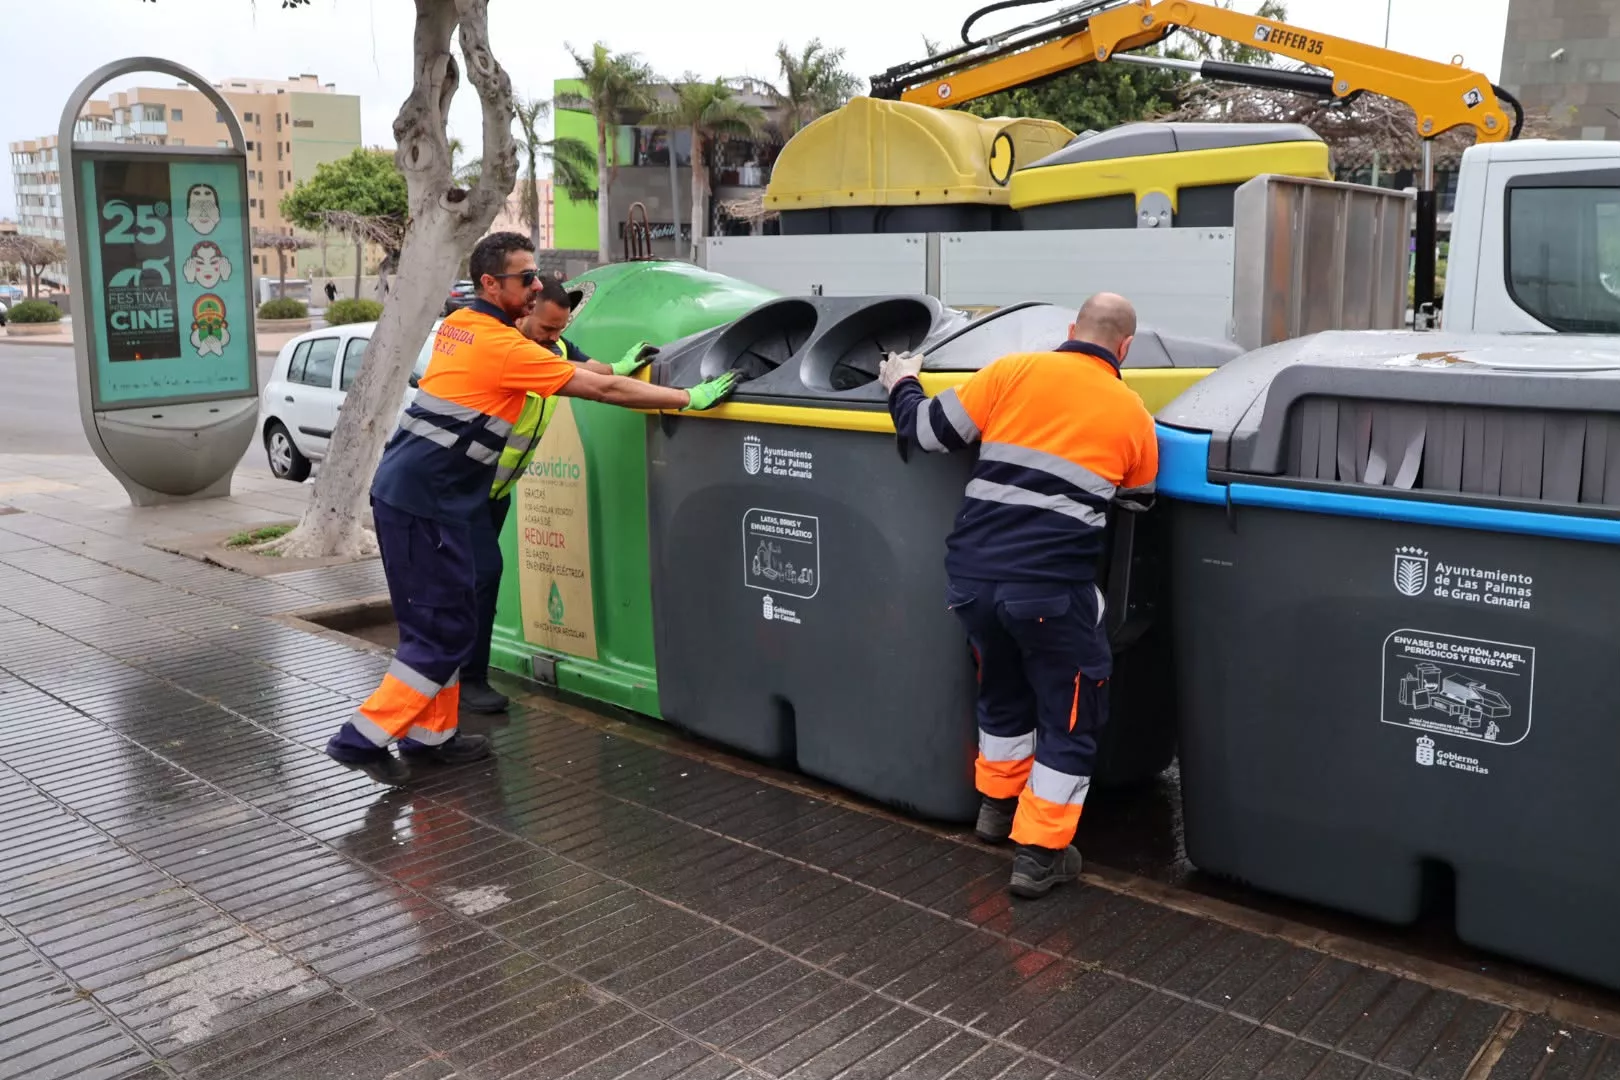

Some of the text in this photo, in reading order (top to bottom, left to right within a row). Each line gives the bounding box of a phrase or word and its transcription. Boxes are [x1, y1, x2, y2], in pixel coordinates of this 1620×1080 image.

[1270, 28, 1324, 55] EFFER 35
[109, 291, 172, 304] FESTIVAL
[111, 309, 174, 330] CINE
[763, 445, 812, 459] Ayuntamiento
[763, 456, 812, 469] de Las Palmas
[763, 465, 812, 479] de Gran Canaria
[750, 522, 775, 533] ENVASES
[785, 528, 813, 539] PLÁSTICO
[760, 515, 779, 525] LATAS,
[796, 520, 802, 528] Y
[525, 528, 565, 548] REDUCIR
[1435, 562, 1533, 585] Ayuntamiento
[1434, 574, 1532, 597] de Las Palmas
[1433, 586, 1531, 610] de Gran Canaria
[1393, 636, 1526, 664] ENVASES DE CARTÓN, PAPEL,
[1404, 645, 1514, 669] PERIÓDICOS Y REVISTAS
[1436, 758, 1489, 774] de Canarias
[1437, 750, 1479, 765] Gobierno
